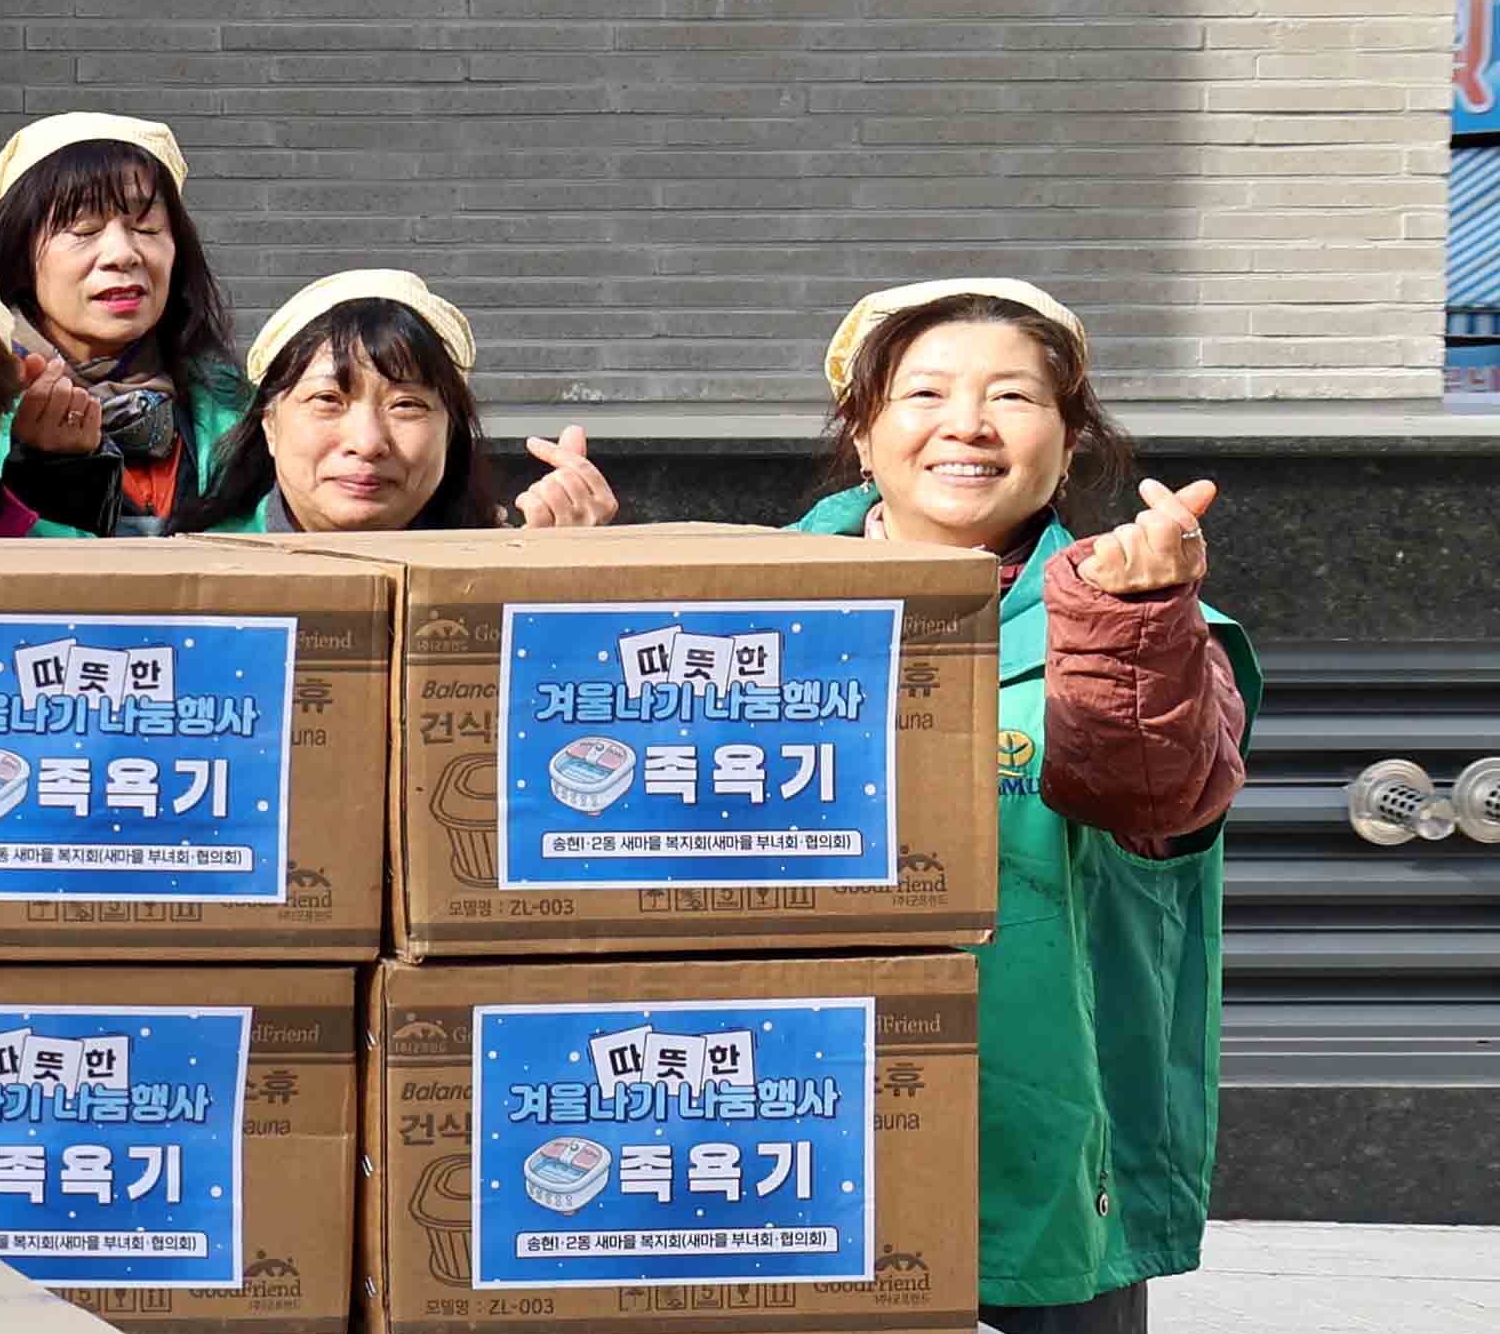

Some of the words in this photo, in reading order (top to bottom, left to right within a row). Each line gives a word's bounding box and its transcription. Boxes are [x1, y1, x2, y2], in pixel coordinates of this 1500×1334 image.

[28, 654, 161, 695] 따뜻한
[634, 639, 766, 683] 따뜻한
[98, 695, 258, 736] 나눔행사
[537, 680, 693, 723] 겨울나기
[705, 679, 864, 722] 나눔행사
[37, 757, 229, 818] 족욕기
[646, 741, 836, 806] 족욕기
[620, 835, 661, 851] 새마을
[608, 1039, 741, 1083] 따뜻한
[53, 1082, 212, 1123] 나눔행사
[510, 1080, 667, 1125] 겨울나기
[679, 1077, 839, 1121] 나눔행사
[620, 1139, 811, 1205] 족욕기
[594, 1234, 635, 1250] 새마을
[487, 1299, 556, 1317] ZL-003
